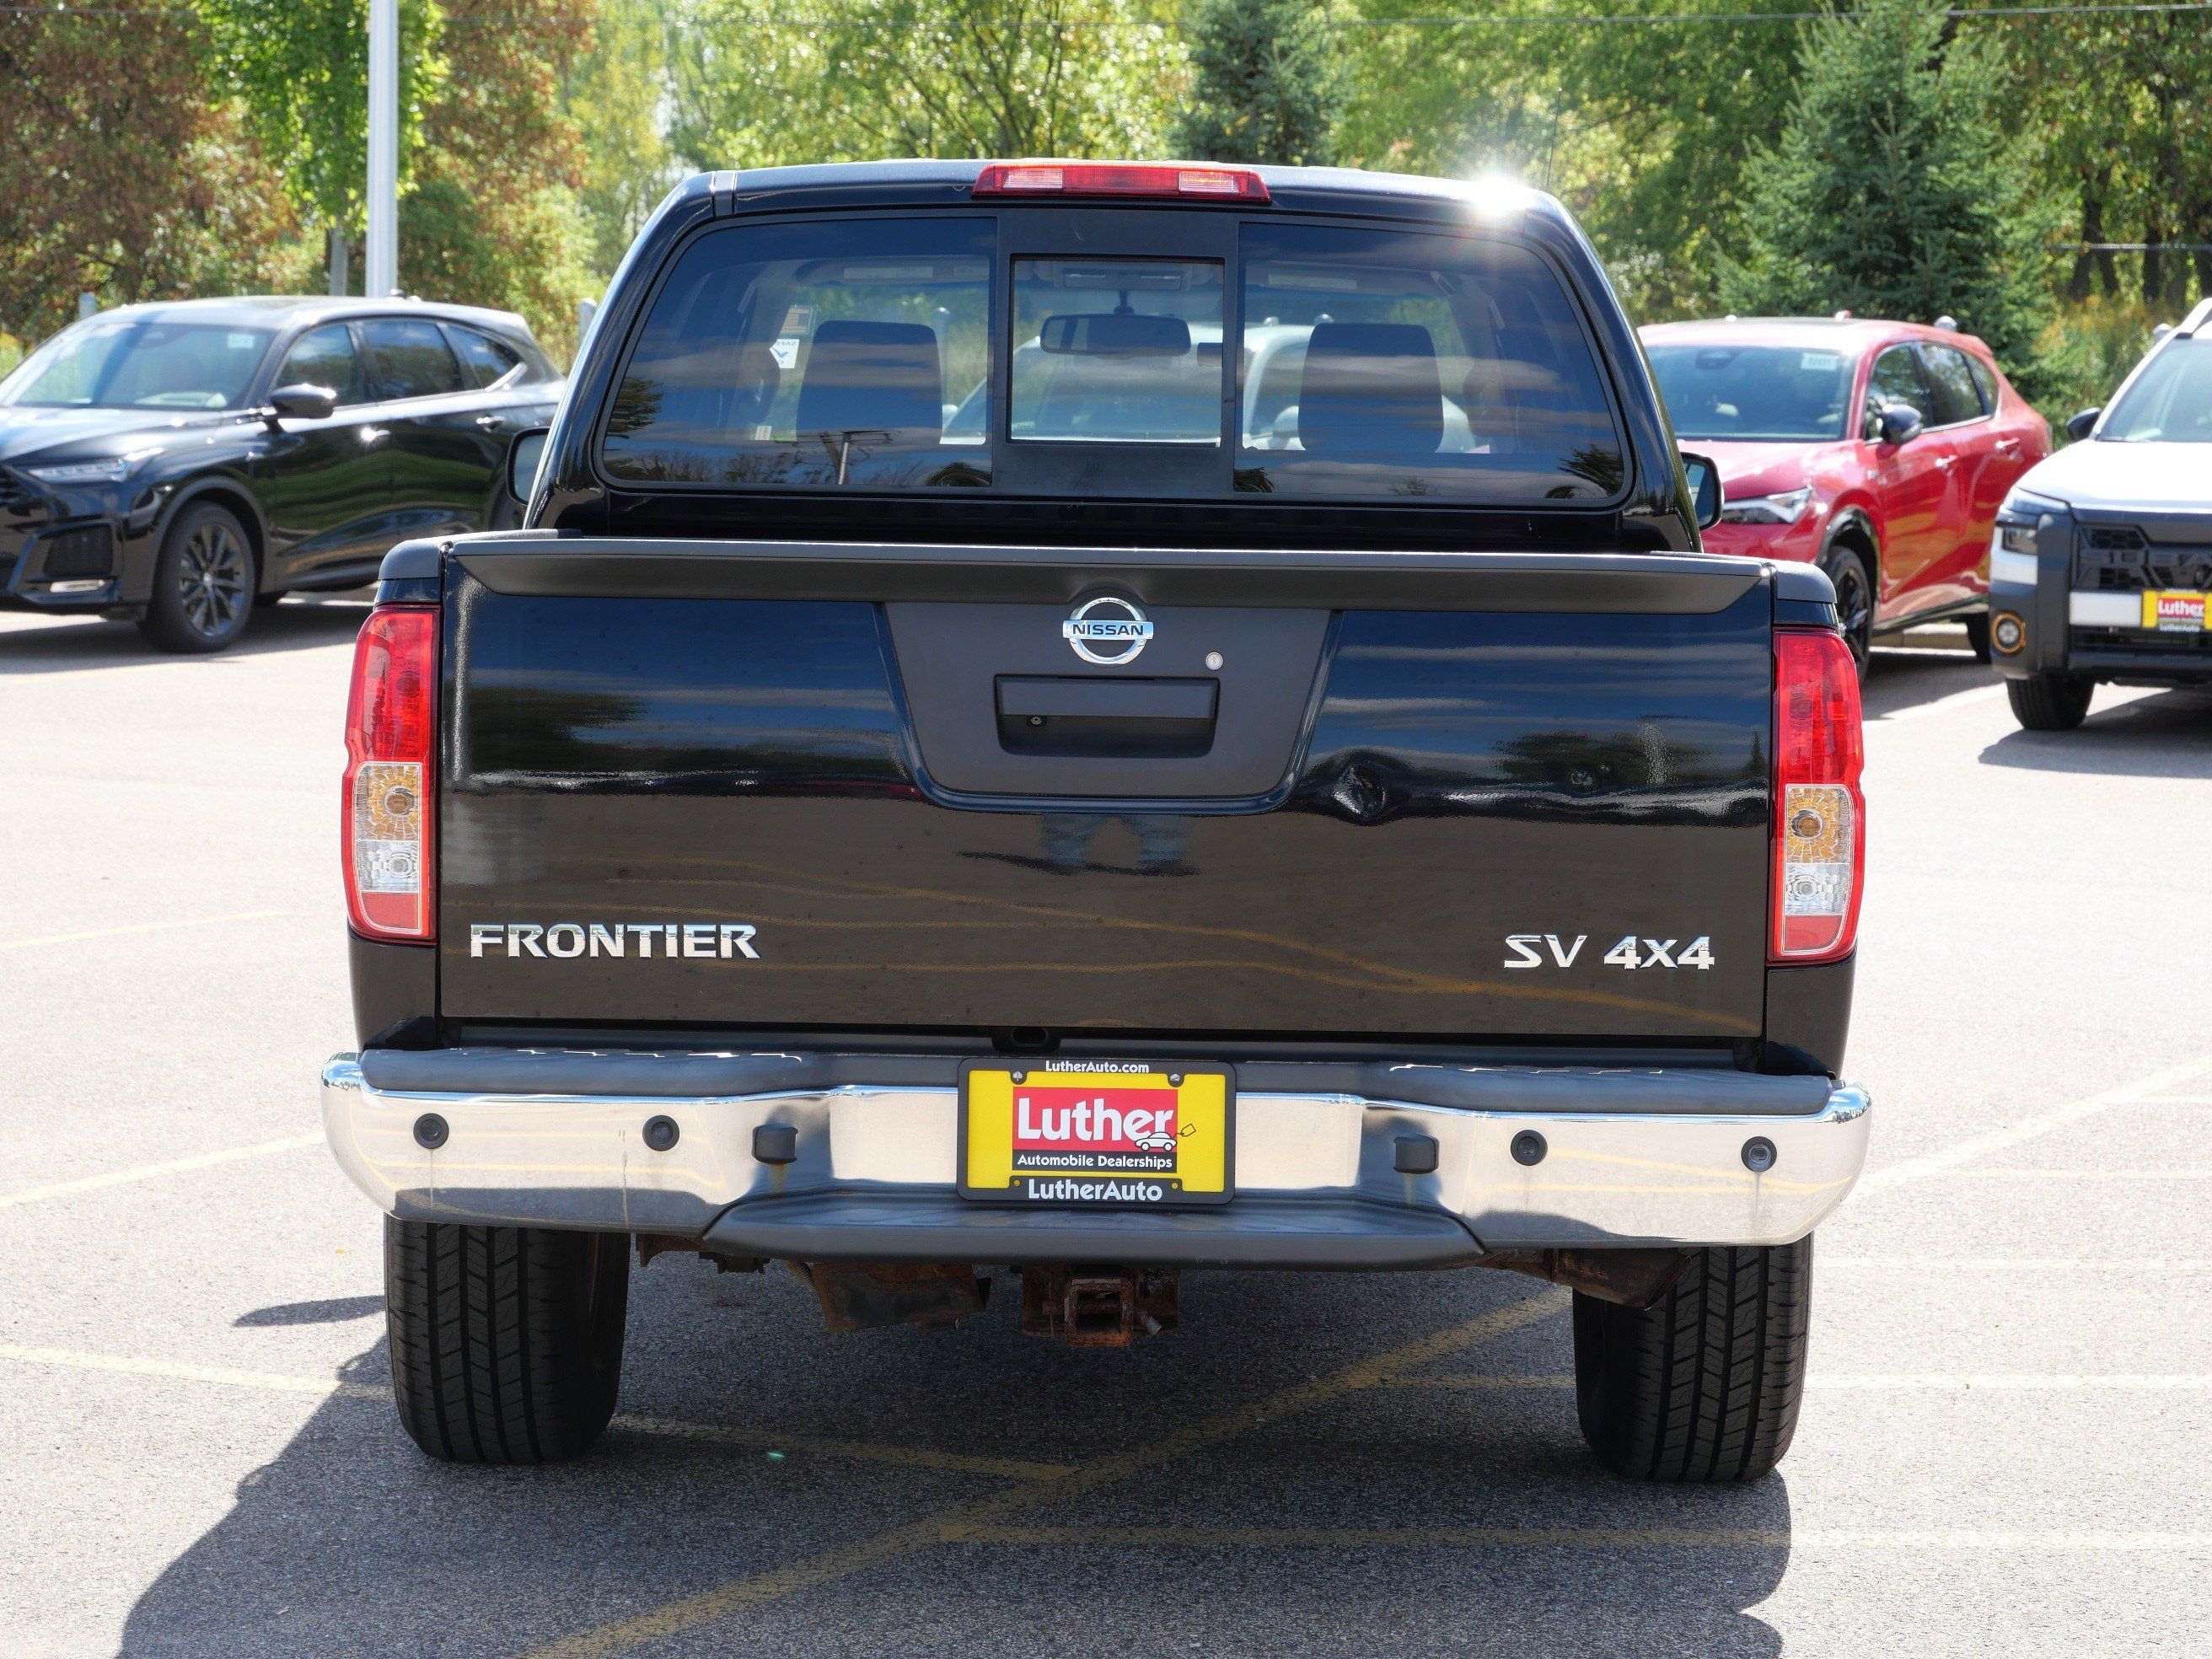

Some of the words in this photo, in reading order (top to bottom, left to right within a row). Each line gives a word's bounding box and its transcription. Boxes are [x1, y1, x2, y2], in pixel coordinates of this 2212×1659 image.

[2158, 599, 2204, 616] Luther
[1072, 624, 1144, 636] NISSAN
[470, 923, 760, 958] FRONTIER
[1504, 934, 1588, 969] SV
[1044, 1060, 1150, 1074] LutherAuto.com
[1017, 1098, 1174, 1141] Luther
[1017, 1154, 1094, 1167] Automobile
[1098, 1155, 1173, 1170] Dealerships
[1028, 1178, 1162, 1201] LutherAuto
